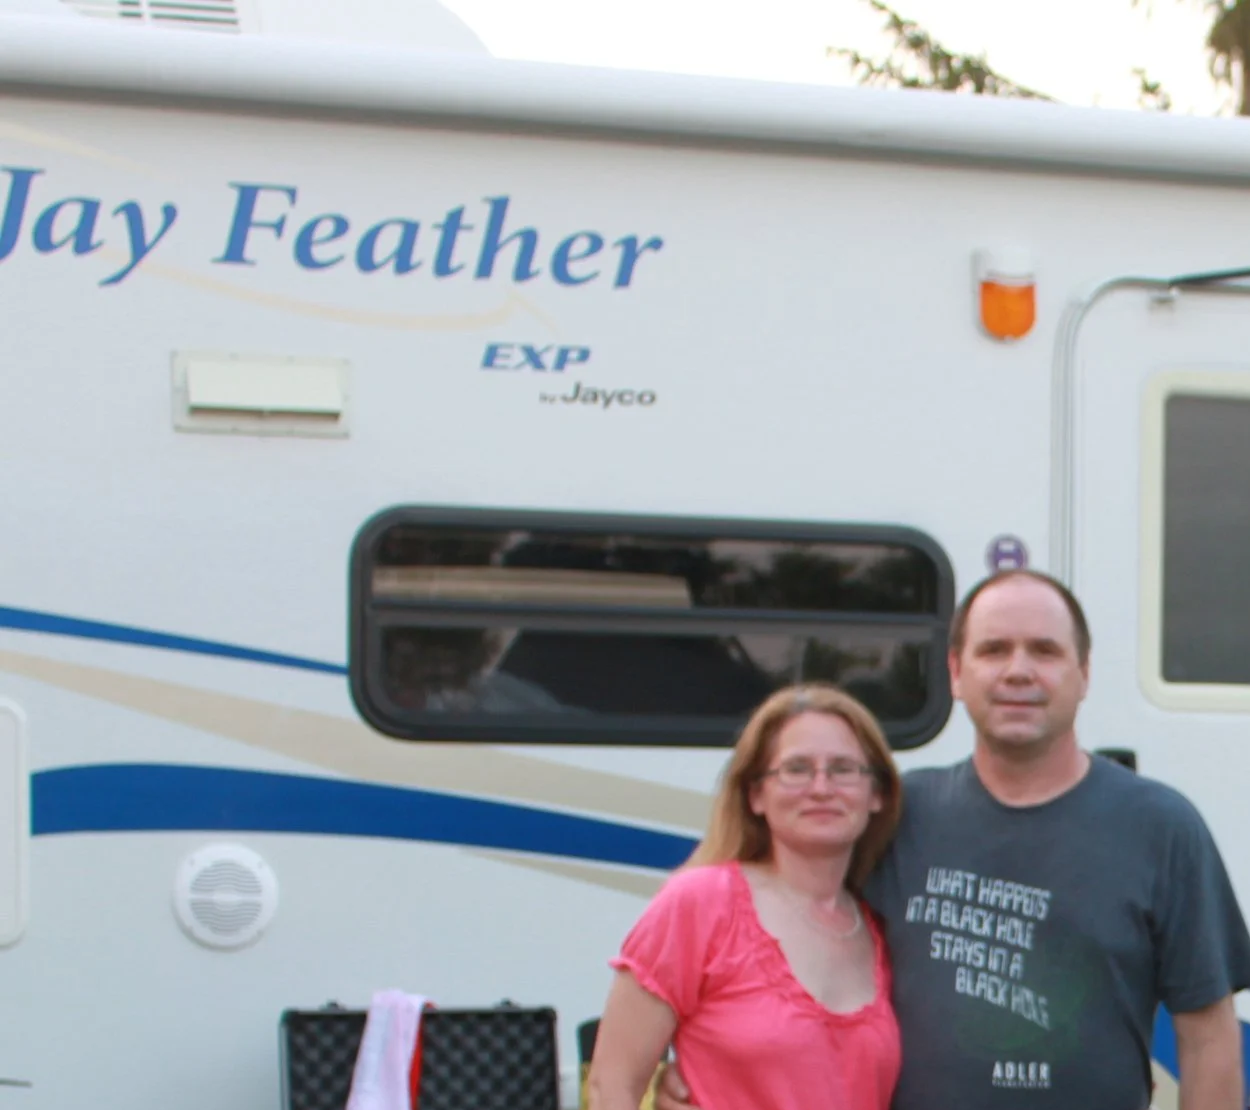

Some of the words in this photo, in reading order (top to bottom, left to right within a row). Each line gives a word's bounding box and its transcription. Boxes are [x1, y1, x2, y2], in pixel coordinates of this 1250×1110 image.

[0, 165, 178, 287] Jay
[211, 181, 664, 290] Feather
[480, 342, 591, 372] EXP
[560, 381, 657, 409] Jayco
[926, 867, 977, 901] WHAT
[925, 898, 938, 923] A
[940, 900, 996, 937] BLACK
[996, 916, 1036, 951] HOLE
[930, 931, 987, 968] STAYS
[1010, 952, 1024, 980] A
[955, 966, 1010, 1008] BLACK
[1011, 984, 1051, 1031] HOLE
[992, 1060, 1051, 1081] ADLER
